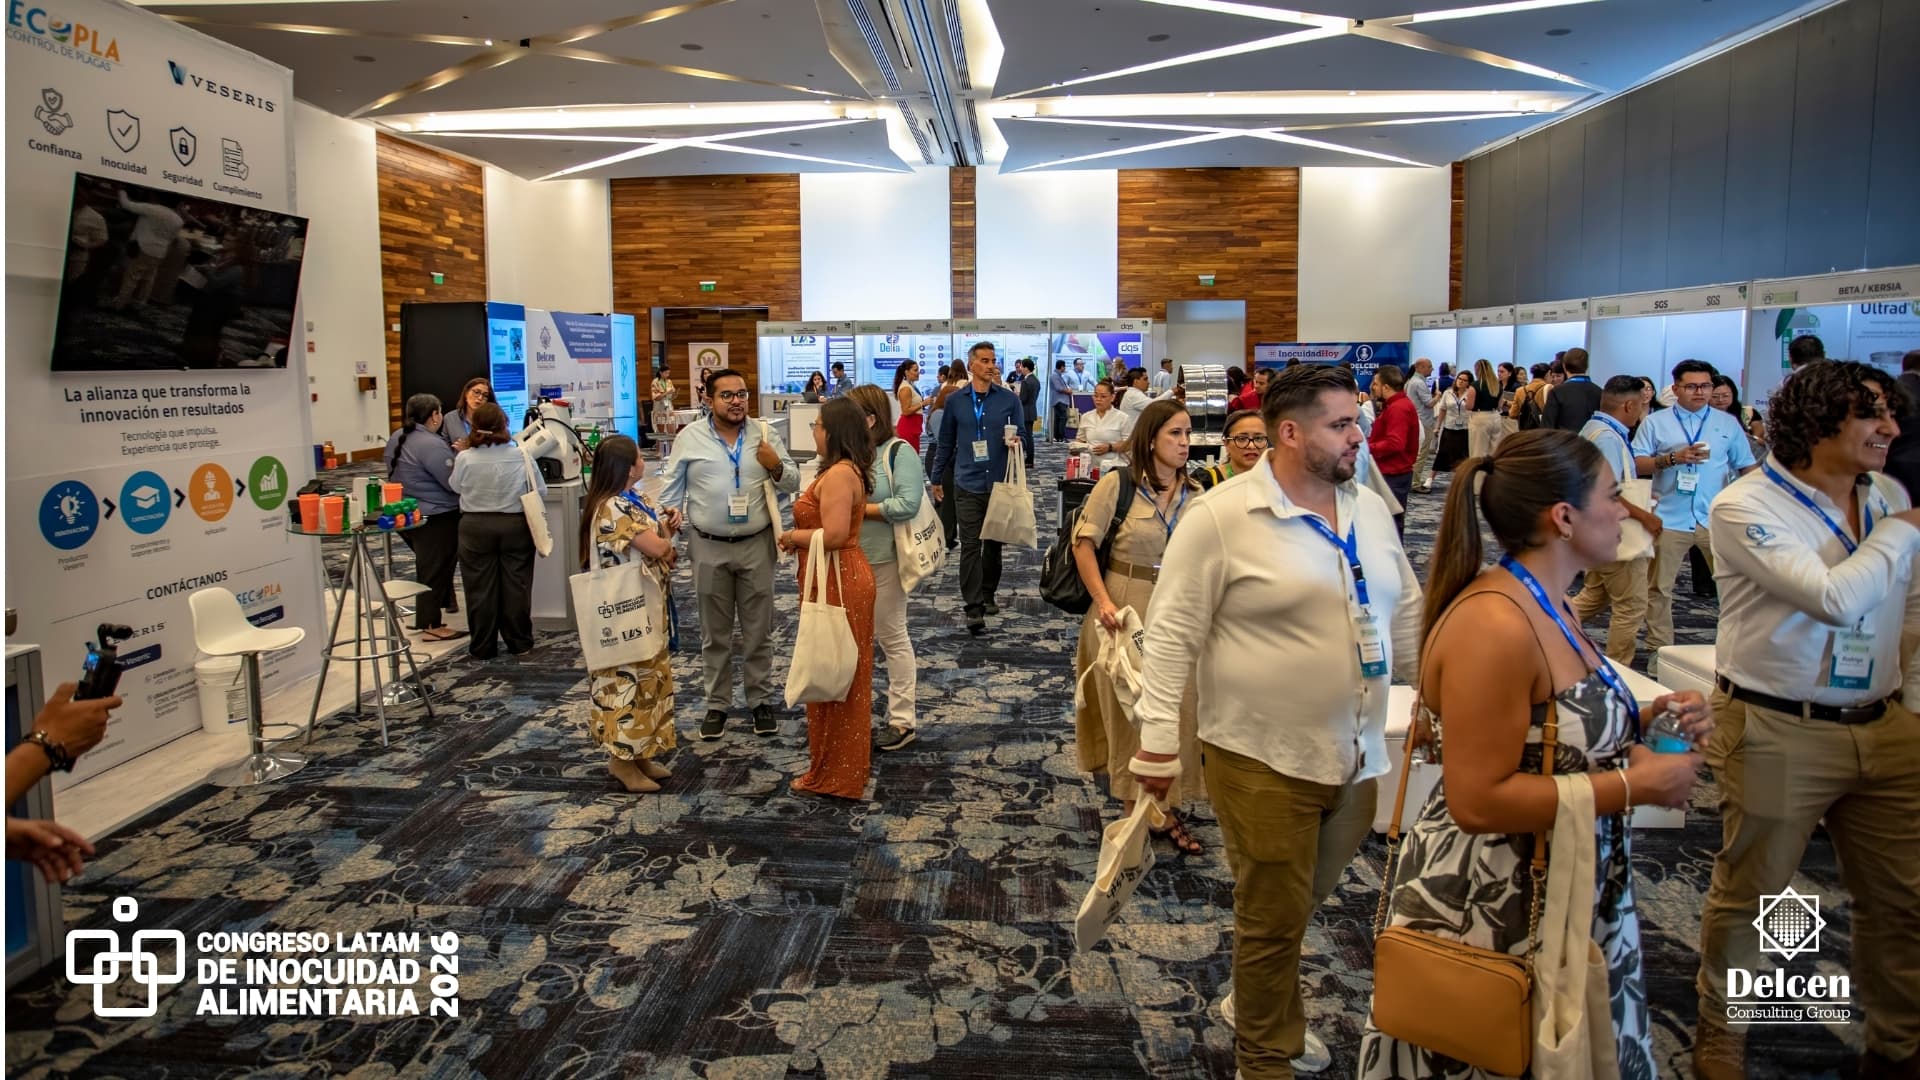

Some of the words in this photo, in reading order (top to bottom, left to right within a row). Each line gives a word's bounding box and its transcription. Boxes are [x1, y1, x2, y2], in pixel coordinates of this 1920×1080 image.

[6, 27, 59, 54] CONTROL
[60, 46, 74, 59] DE
[76, 51, 112, 72] PLAGAS
[190, 74, 275, 112] VESERIS
[28, 139, 82, 160] Confianza
[101, 156, 147, 175] Inocuidad
[162, 170, 203, 187] Seguridad
[213, 182, 262, 199] Cumplimiento
[1838, 286, 1860, 295] BETA
[1861, 284, 1867, 294] /
[1868, 282, 1902, 293] KERSIA
[1654, 300, 1668, 309] SGS
[1706, 295, 1720, 306] SGS
[1121, 343, 1139, 353] dqs
[1356, 368, 1373, 376] Talks
[64, 388, 82, 402] La
[87, 386, 138, 401] alianza
[142, 387, 167, 402] que
[170, 384, 238, 398] transforma
[240, 383, 251, 395] la
[80, 406, 159, 423] innovación
[163, 407, 179, 418] en
[182, 402, 244, 417] resultados
[121, 430, 168, 443] Tecnología
[169, 430, 185, 440] que
[121, 443, 171, 456] Experiencia
[172, 442, 188, 452] que
[147, 570, 228, 600] CONTÁCTANOS
